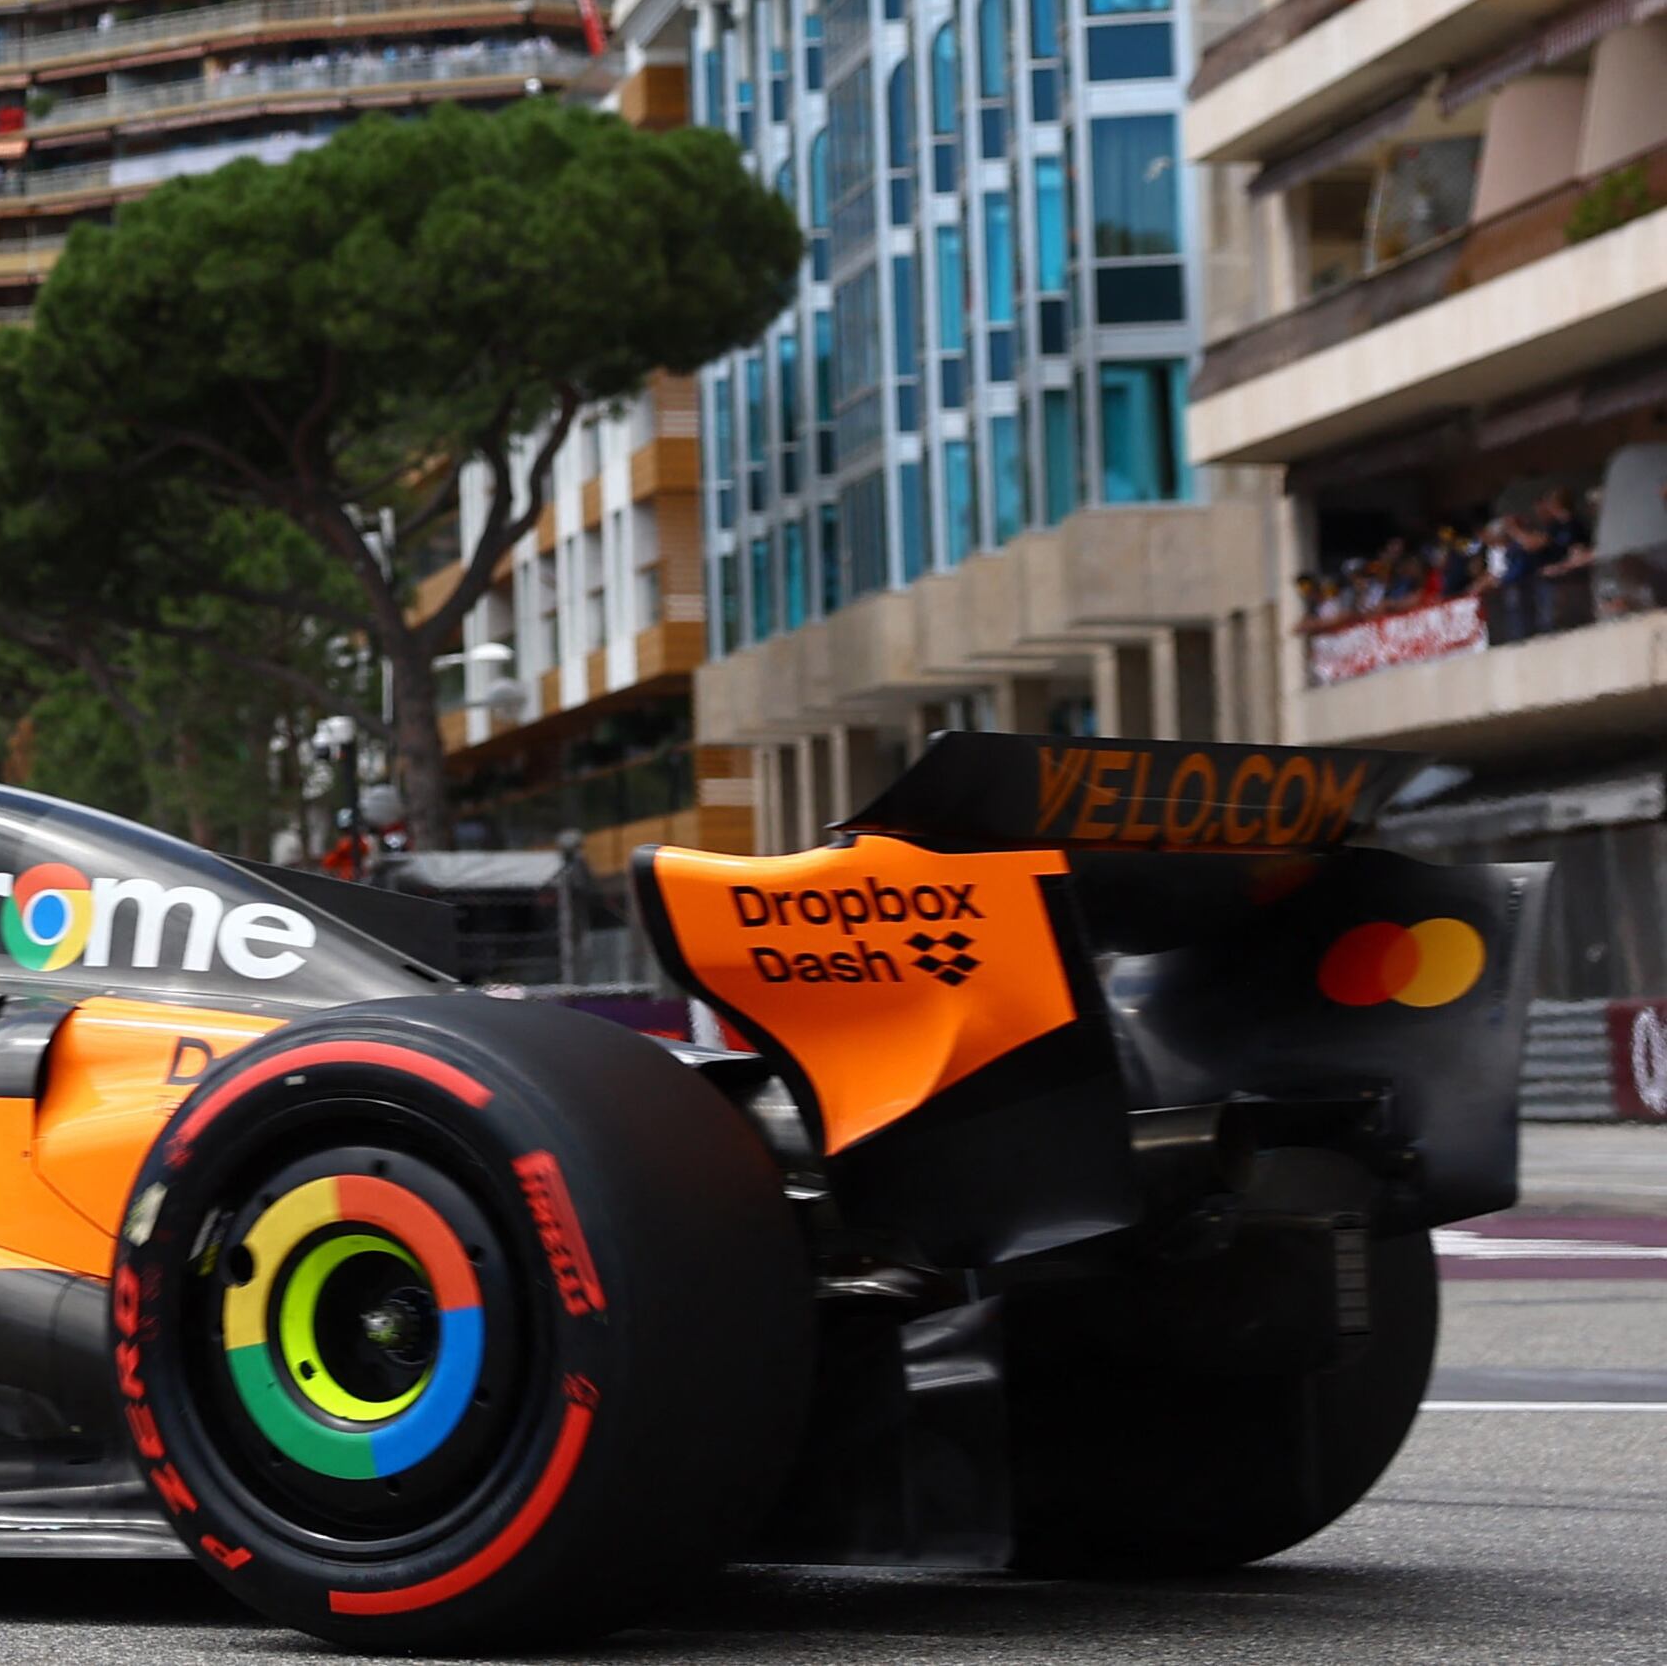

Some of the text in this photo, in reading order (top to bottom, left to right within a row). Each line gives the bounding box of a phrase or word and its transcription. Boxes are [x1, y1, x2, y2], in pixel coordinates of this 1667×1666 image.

[1036, 745, 1367, 845] VELO.COM
[728, 876, 987, 935] Dropbox
[748, 940, 905, 983] Dash
